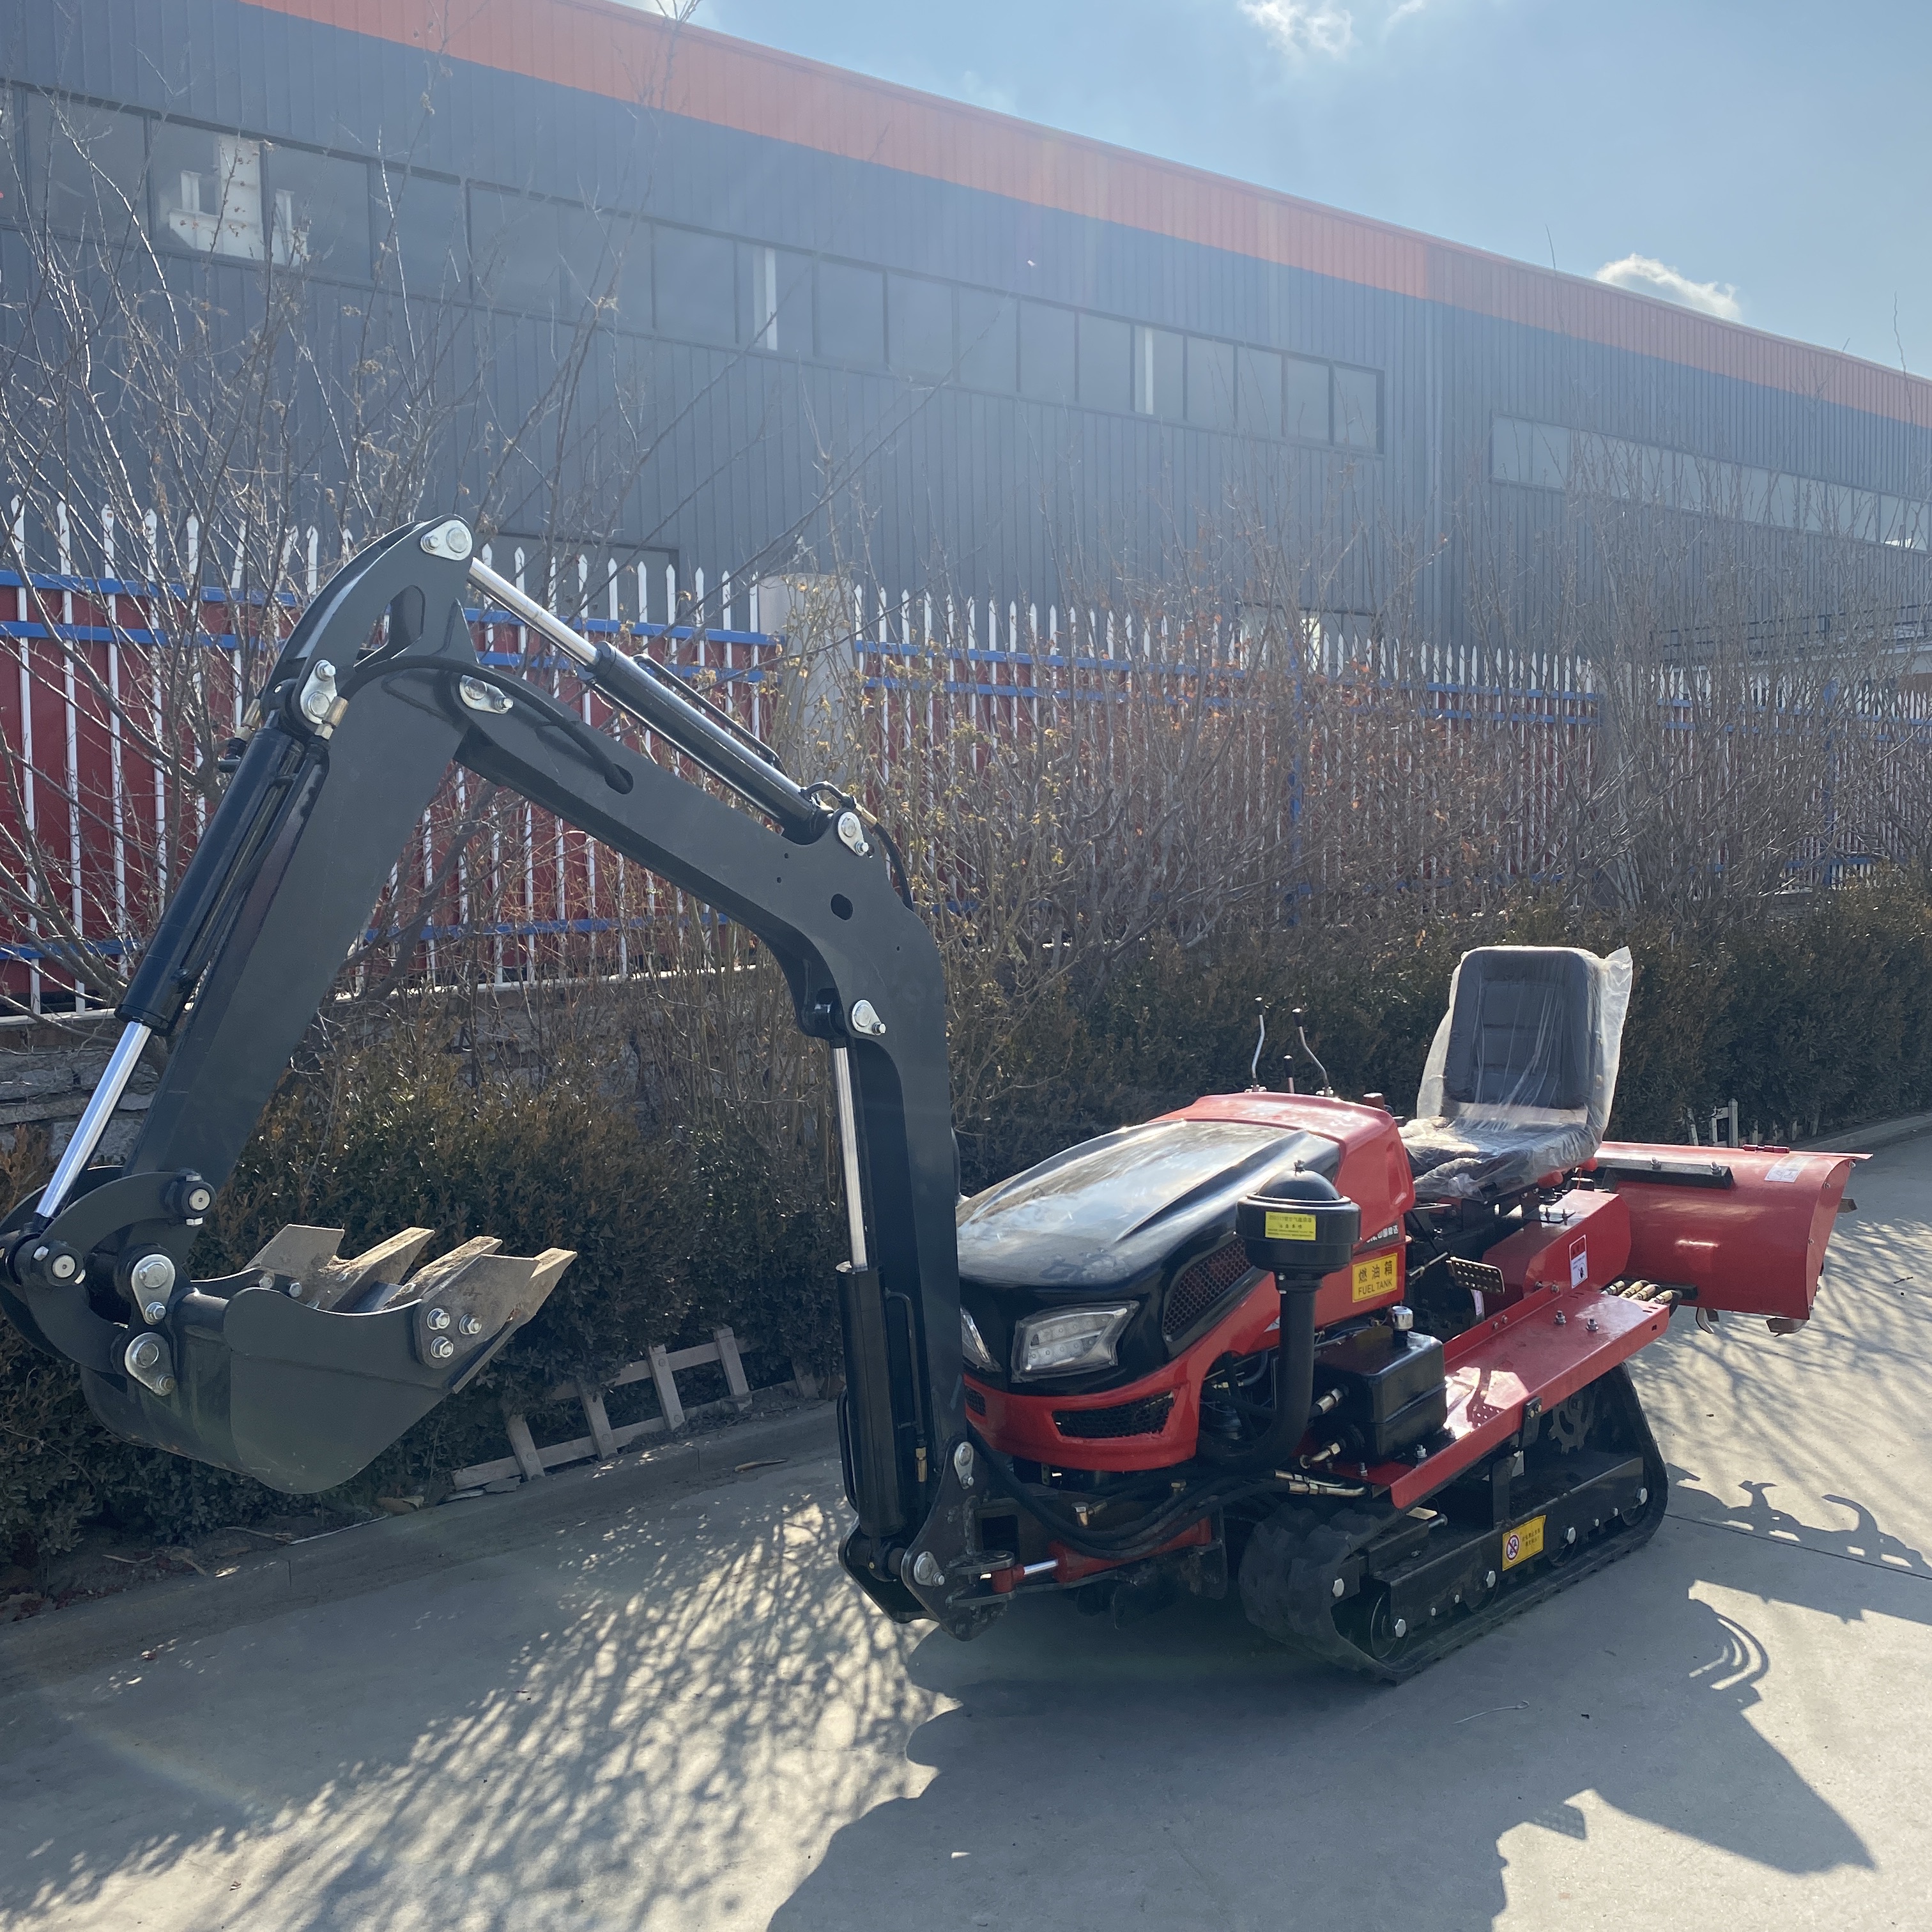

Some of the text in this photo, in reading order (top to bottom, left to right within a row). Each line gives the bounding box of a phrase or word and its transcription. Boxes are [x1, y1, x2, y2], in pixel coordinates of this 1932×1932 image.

[1358, 1260, 1392, 1284] 燃油箱
[1358, 1278, 1392, 1296] FUEL TANK
